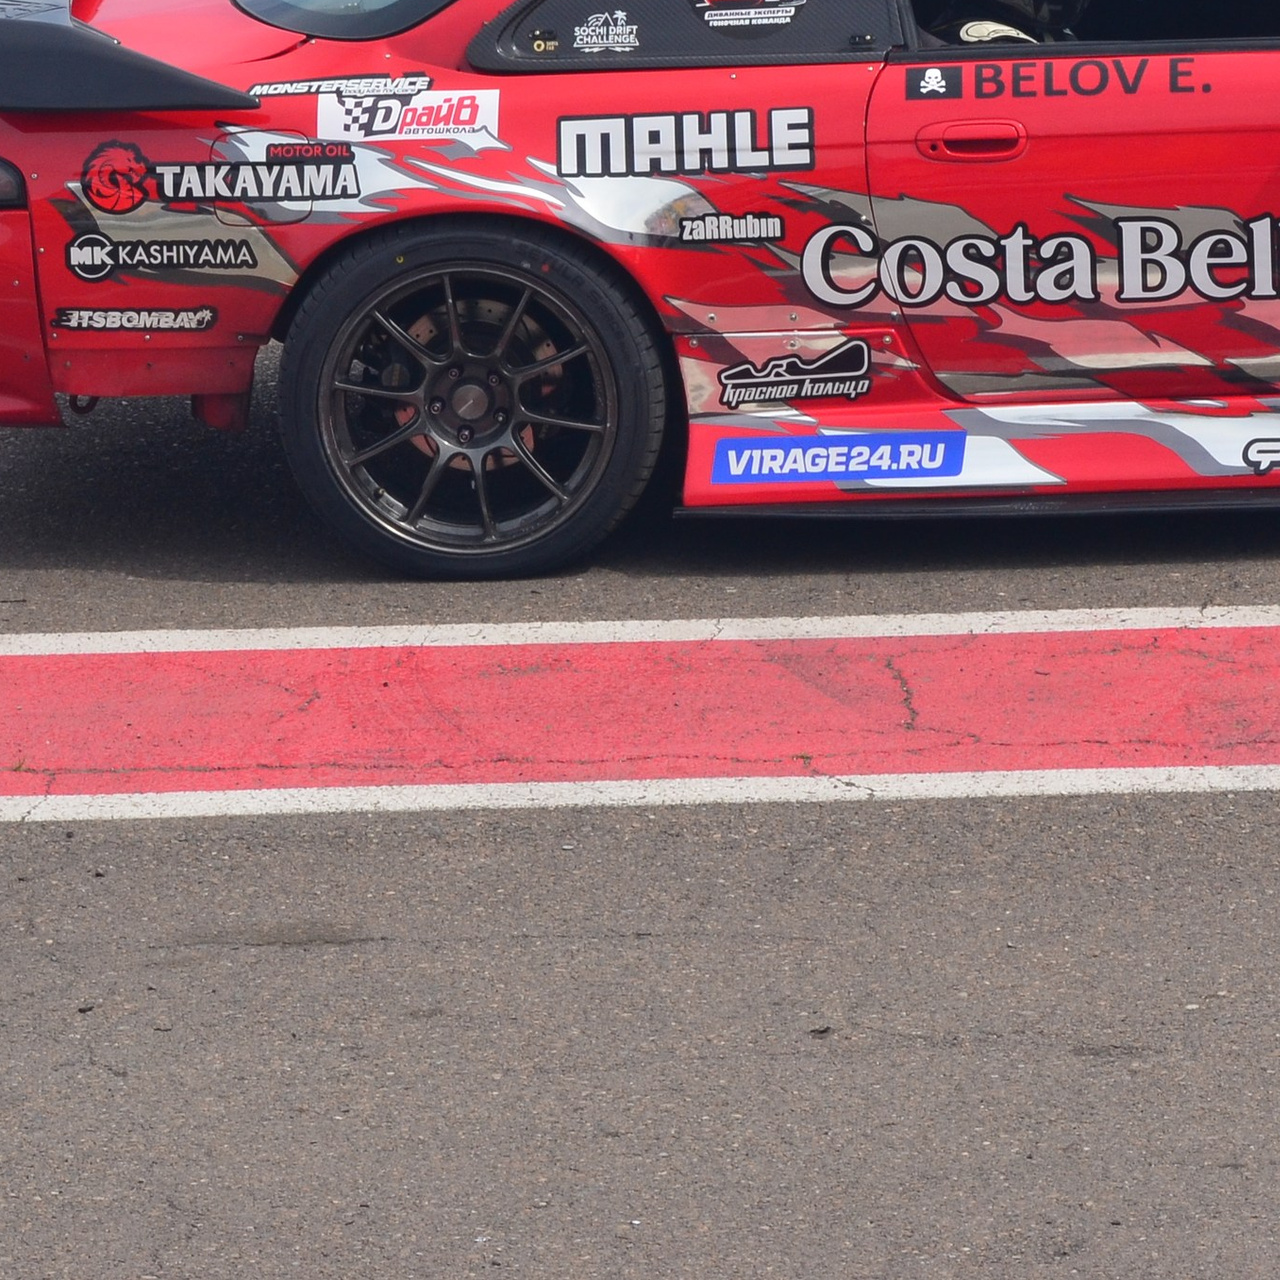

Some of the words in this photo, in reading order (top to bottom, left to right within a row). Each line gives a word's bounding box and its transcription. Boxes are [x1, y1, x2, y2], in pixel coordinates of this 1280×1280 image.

[574, 26, 607, 36] SOCHI
[609, 26, 638, 35] DRIFT
[576, 35, 636, 44] CHALLENGE
[974, 58, 1150, 99] BELOV
[1168, 57, 1213, 95] E.
[270, 145, 322, 158] MOTOR
[326, 144, 350, 157] OIL
[561, 108, 811, 175] MAHLE
[156, 164, 358, 197] TAKAYAMA
[70, 246, 113, 265] MK
[118, 243, 254, 265] KASHIYAMA
[802, 225, 1095, 306] Costa
[727, 443, 945, 476] VIRAGE24.RU
